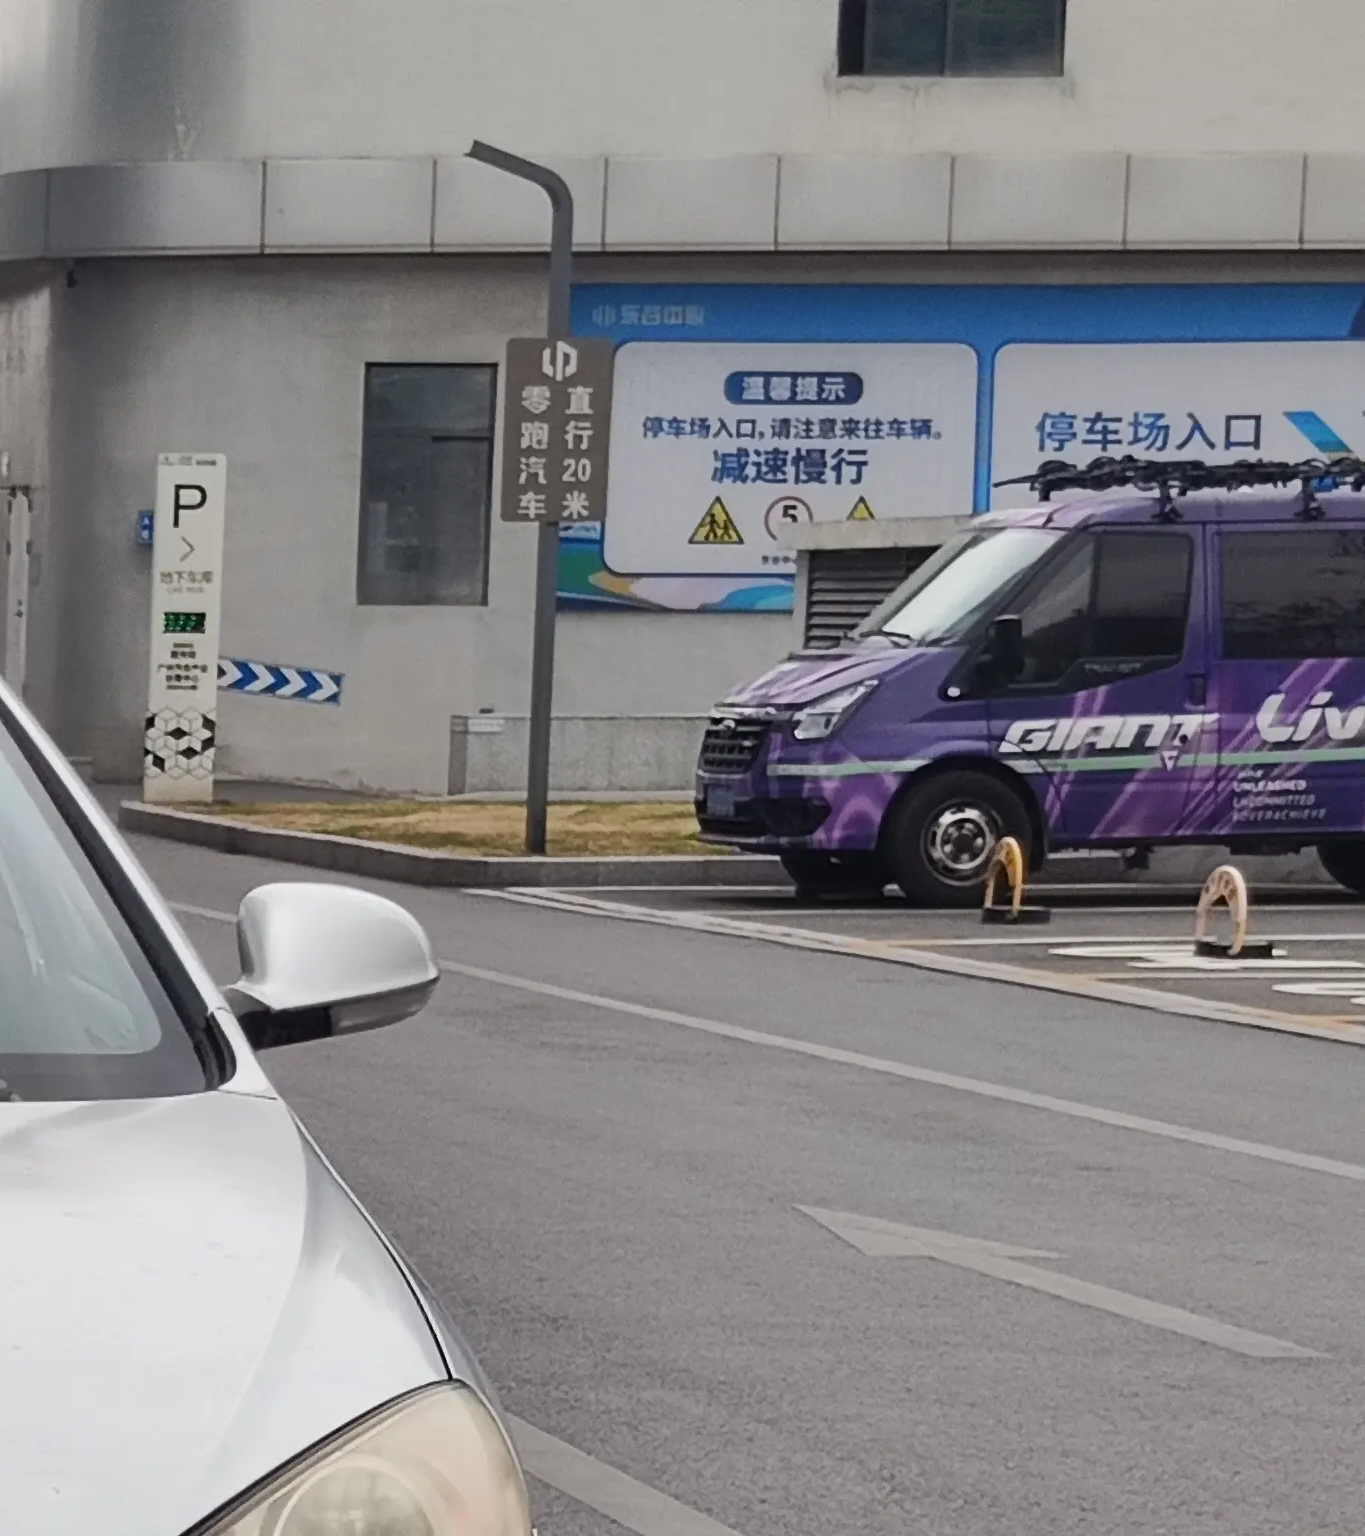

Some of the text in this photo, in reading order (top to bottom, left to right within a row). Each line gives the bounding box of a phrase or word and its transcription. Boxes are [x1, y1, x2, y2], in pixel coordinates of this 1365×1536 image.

[741, 376, 847, 401] 温馨提示
[517, 385, 551, 519] 零跑汽车
[1035, 411, 1262, 452] 停车场入口
[561, 385, 595, 520] 直行20米
[711, 448, 869, 485] 减速慢行
[173, 484, 208, 528] P
[999, 713, 1219, 753] GIANT
